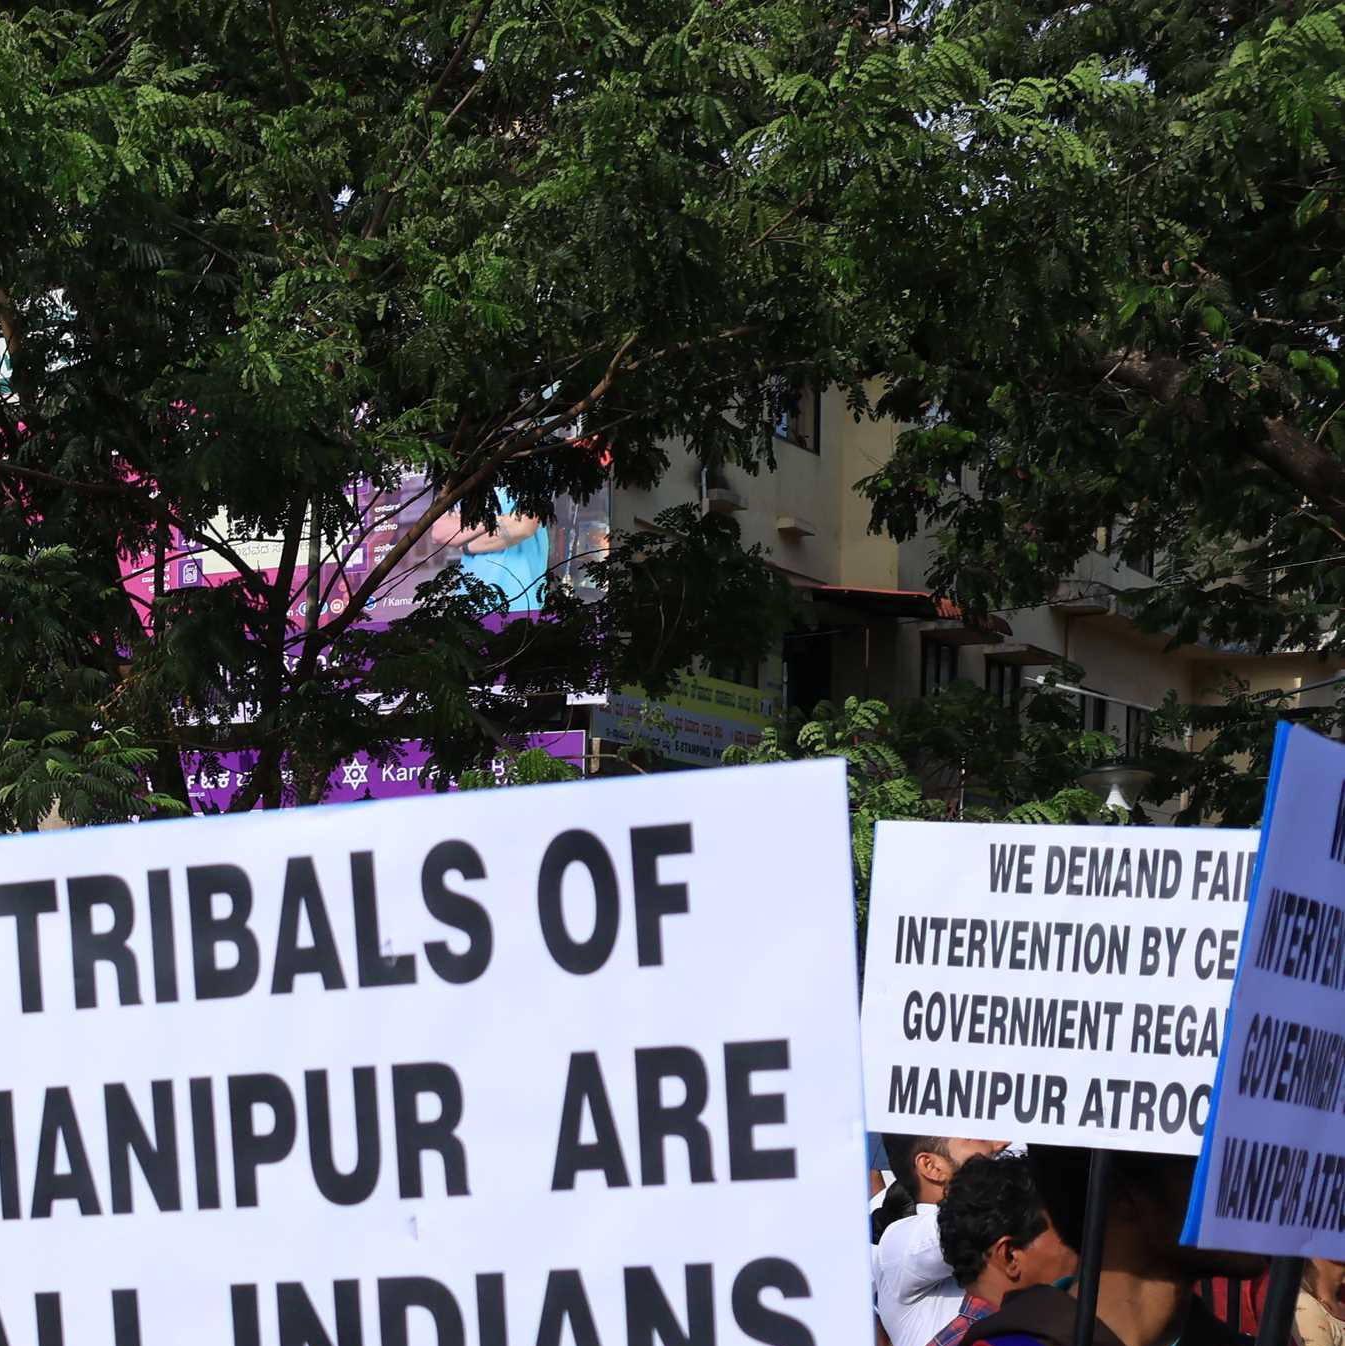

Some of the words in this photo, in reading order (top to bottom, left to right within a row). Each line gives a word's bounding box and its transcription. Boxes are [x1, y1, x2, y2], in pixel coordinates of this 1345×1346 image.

[537, 822, 693, 975] OF
[989, 843, 1036, 894] WE
[1044, 846, 1182, 900] DEMAND
[895, 915, 1131, 976] INTERVENTION
[1140, 926, 1187, 978] BY
[1195, 929, 1239, 980] CE
[902, 990, 1122, 1052] GOVERNMENT
[1131, 1003, 1229, 1059] REGA
[551, 1038, 798, 1191] ARE
[888, 1064, 1068, 1126] MANIPUR
[1079, 1077, 1212, 1136] ATROC
[1215, 1136, 1309, 1227] MANIPUR
